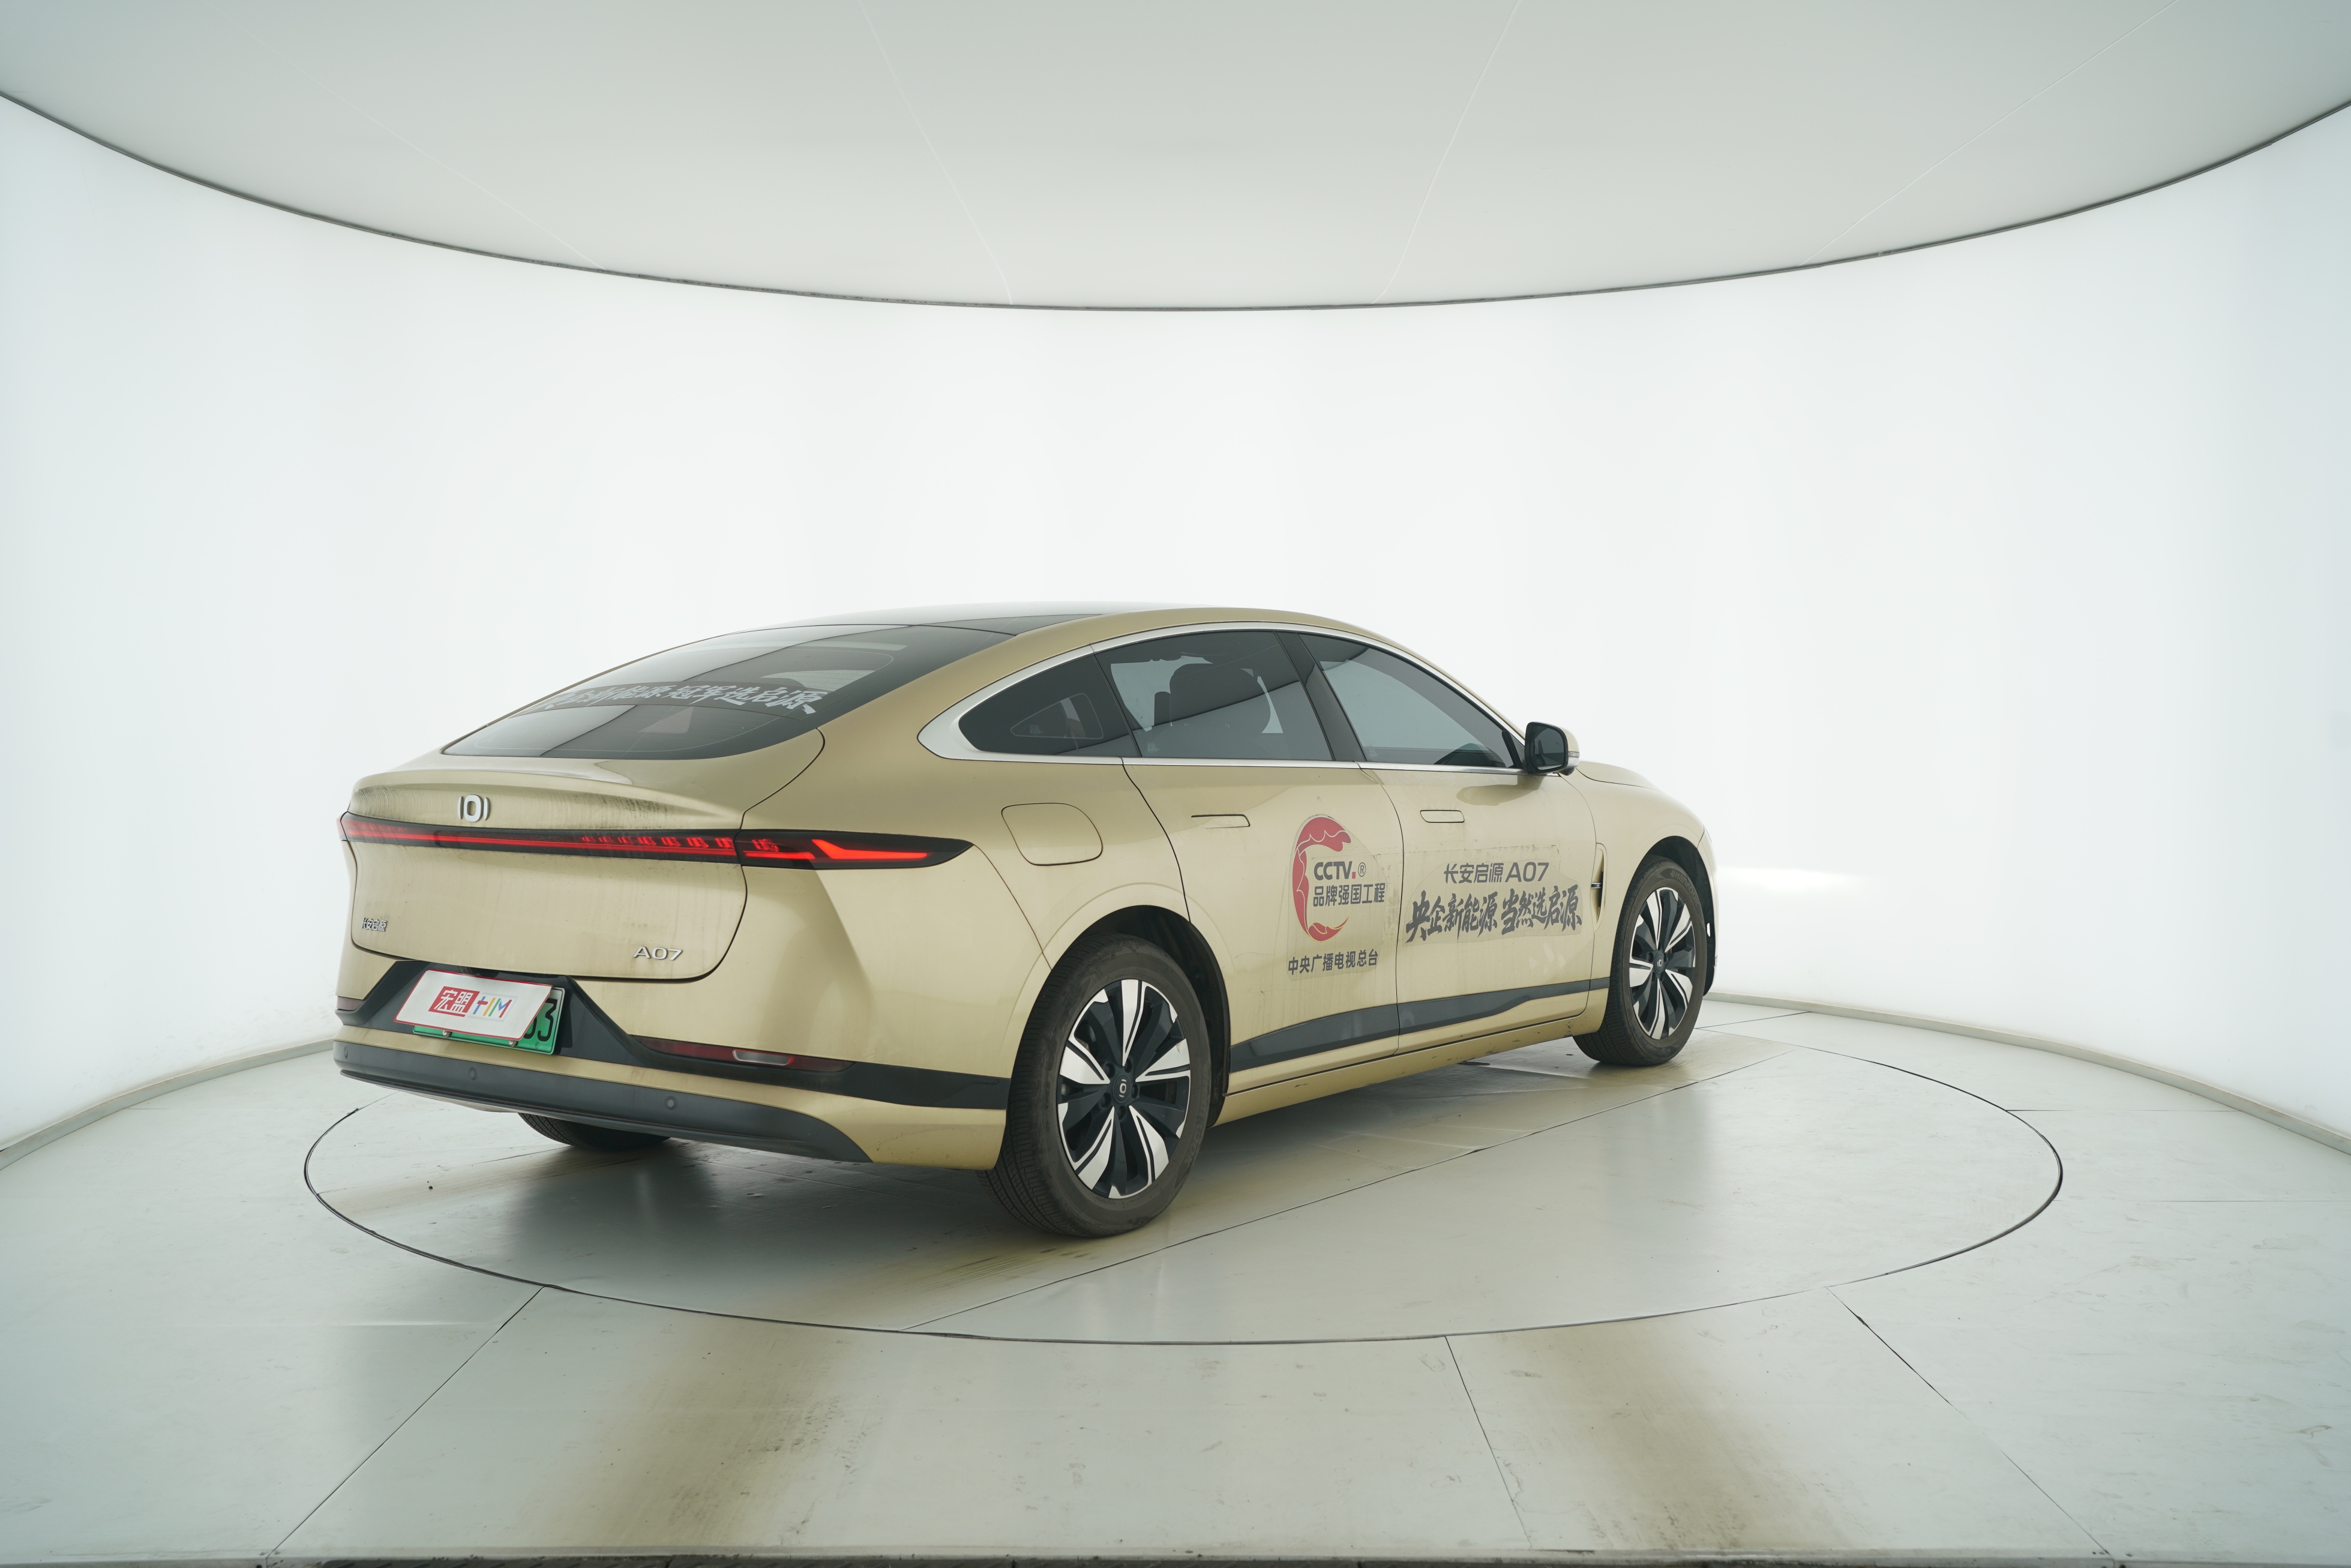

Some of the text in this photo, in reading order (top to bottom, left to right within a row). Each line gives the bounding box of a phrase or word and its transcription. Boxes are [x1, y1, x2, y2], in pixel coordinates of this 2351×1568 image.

[1444, 862, 1549, 884] 长安启源 A07
[1313, 883, 1386, 907] 品牌强国工程
[1405, 884, 1582, 943] 央企新能源 当然选启源
[633, 946, 683, 961] A07
[1288, 949, 1378, 975] 中央广播电视总台
[434, 990, 473, 1015] 宏盟
